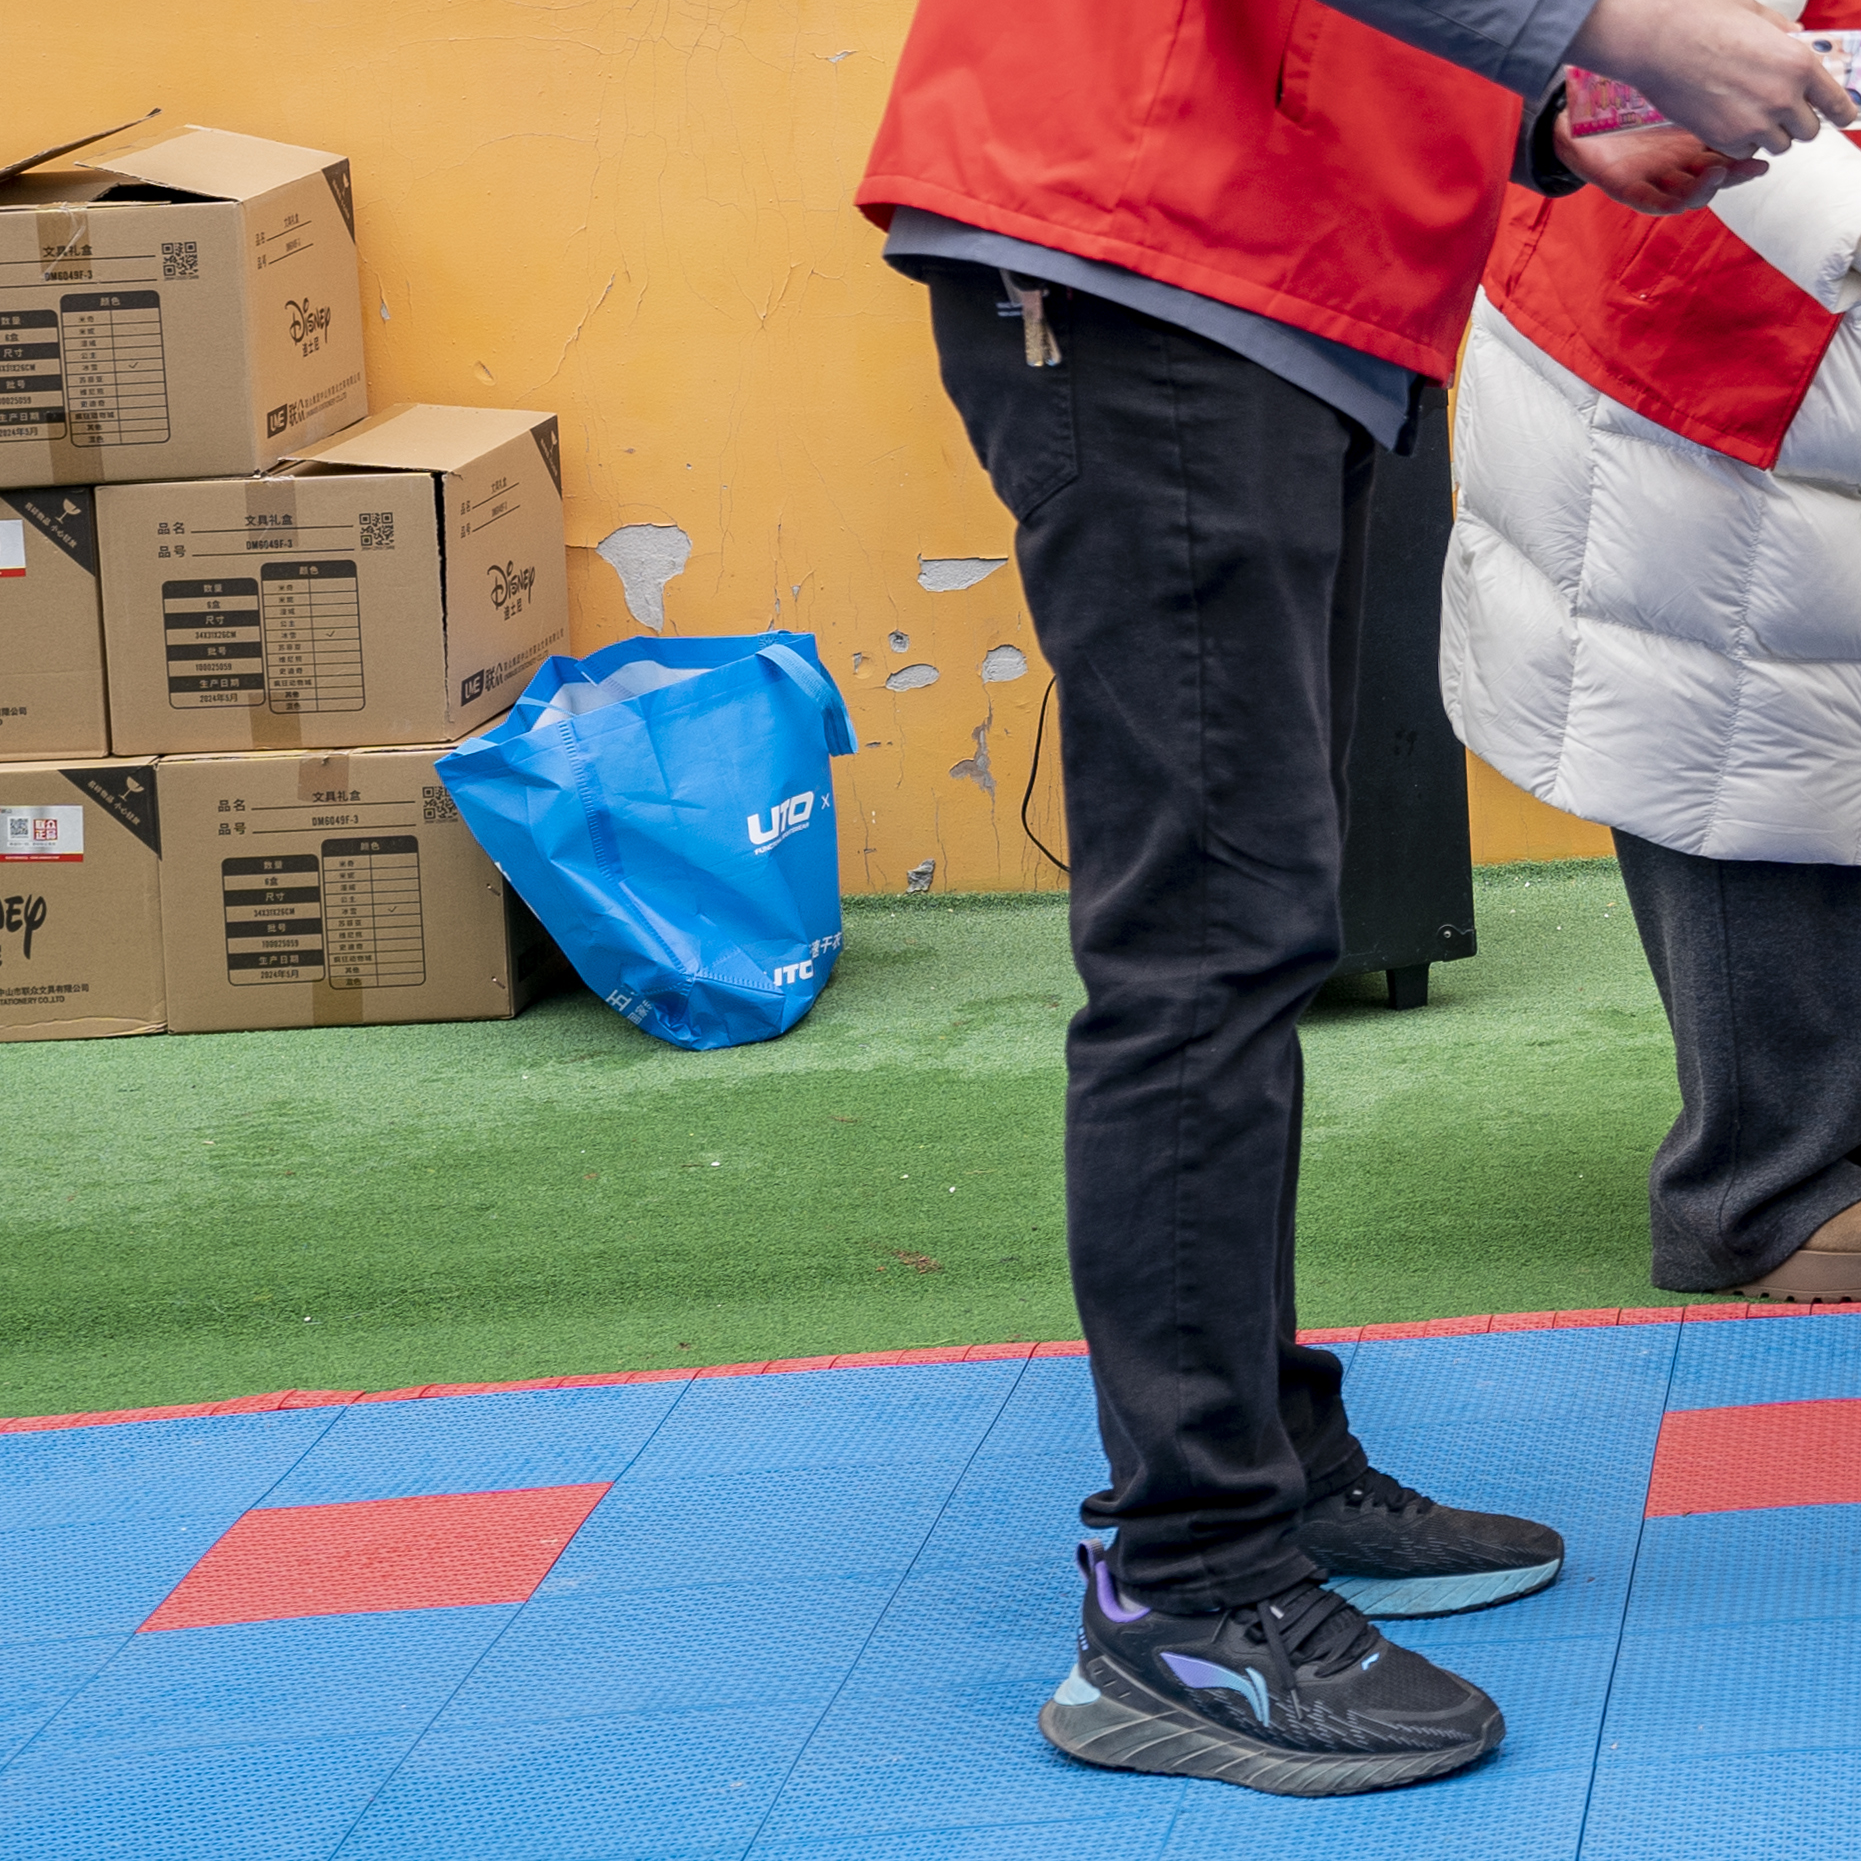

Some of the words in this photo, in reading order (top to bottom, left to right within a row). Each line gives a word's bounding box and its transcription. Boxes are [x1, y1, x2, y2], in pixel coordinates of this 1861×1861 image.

[157, 521, 185, 535] 品名
[244, 514, 293, 527] 文具礼盒
[158, 545, 186, 558] 品号
[246, 539, 293, 550] DM6049F-3
[205, 615, 225, 625] 尺寸
[199, 678, 240, 688] 生产日期
[218, 799, 246, 812] 品名
[312, 790, 361, 803] 文具礼盒
[218, 822, 246, 835] 品号
[311, 815, 359, 826] DM6049F-3
[747, 791, 815, 845] UTO
[265, 892, 285, 902] 尺寸
[258, 955, 299, 965] 生产日期
